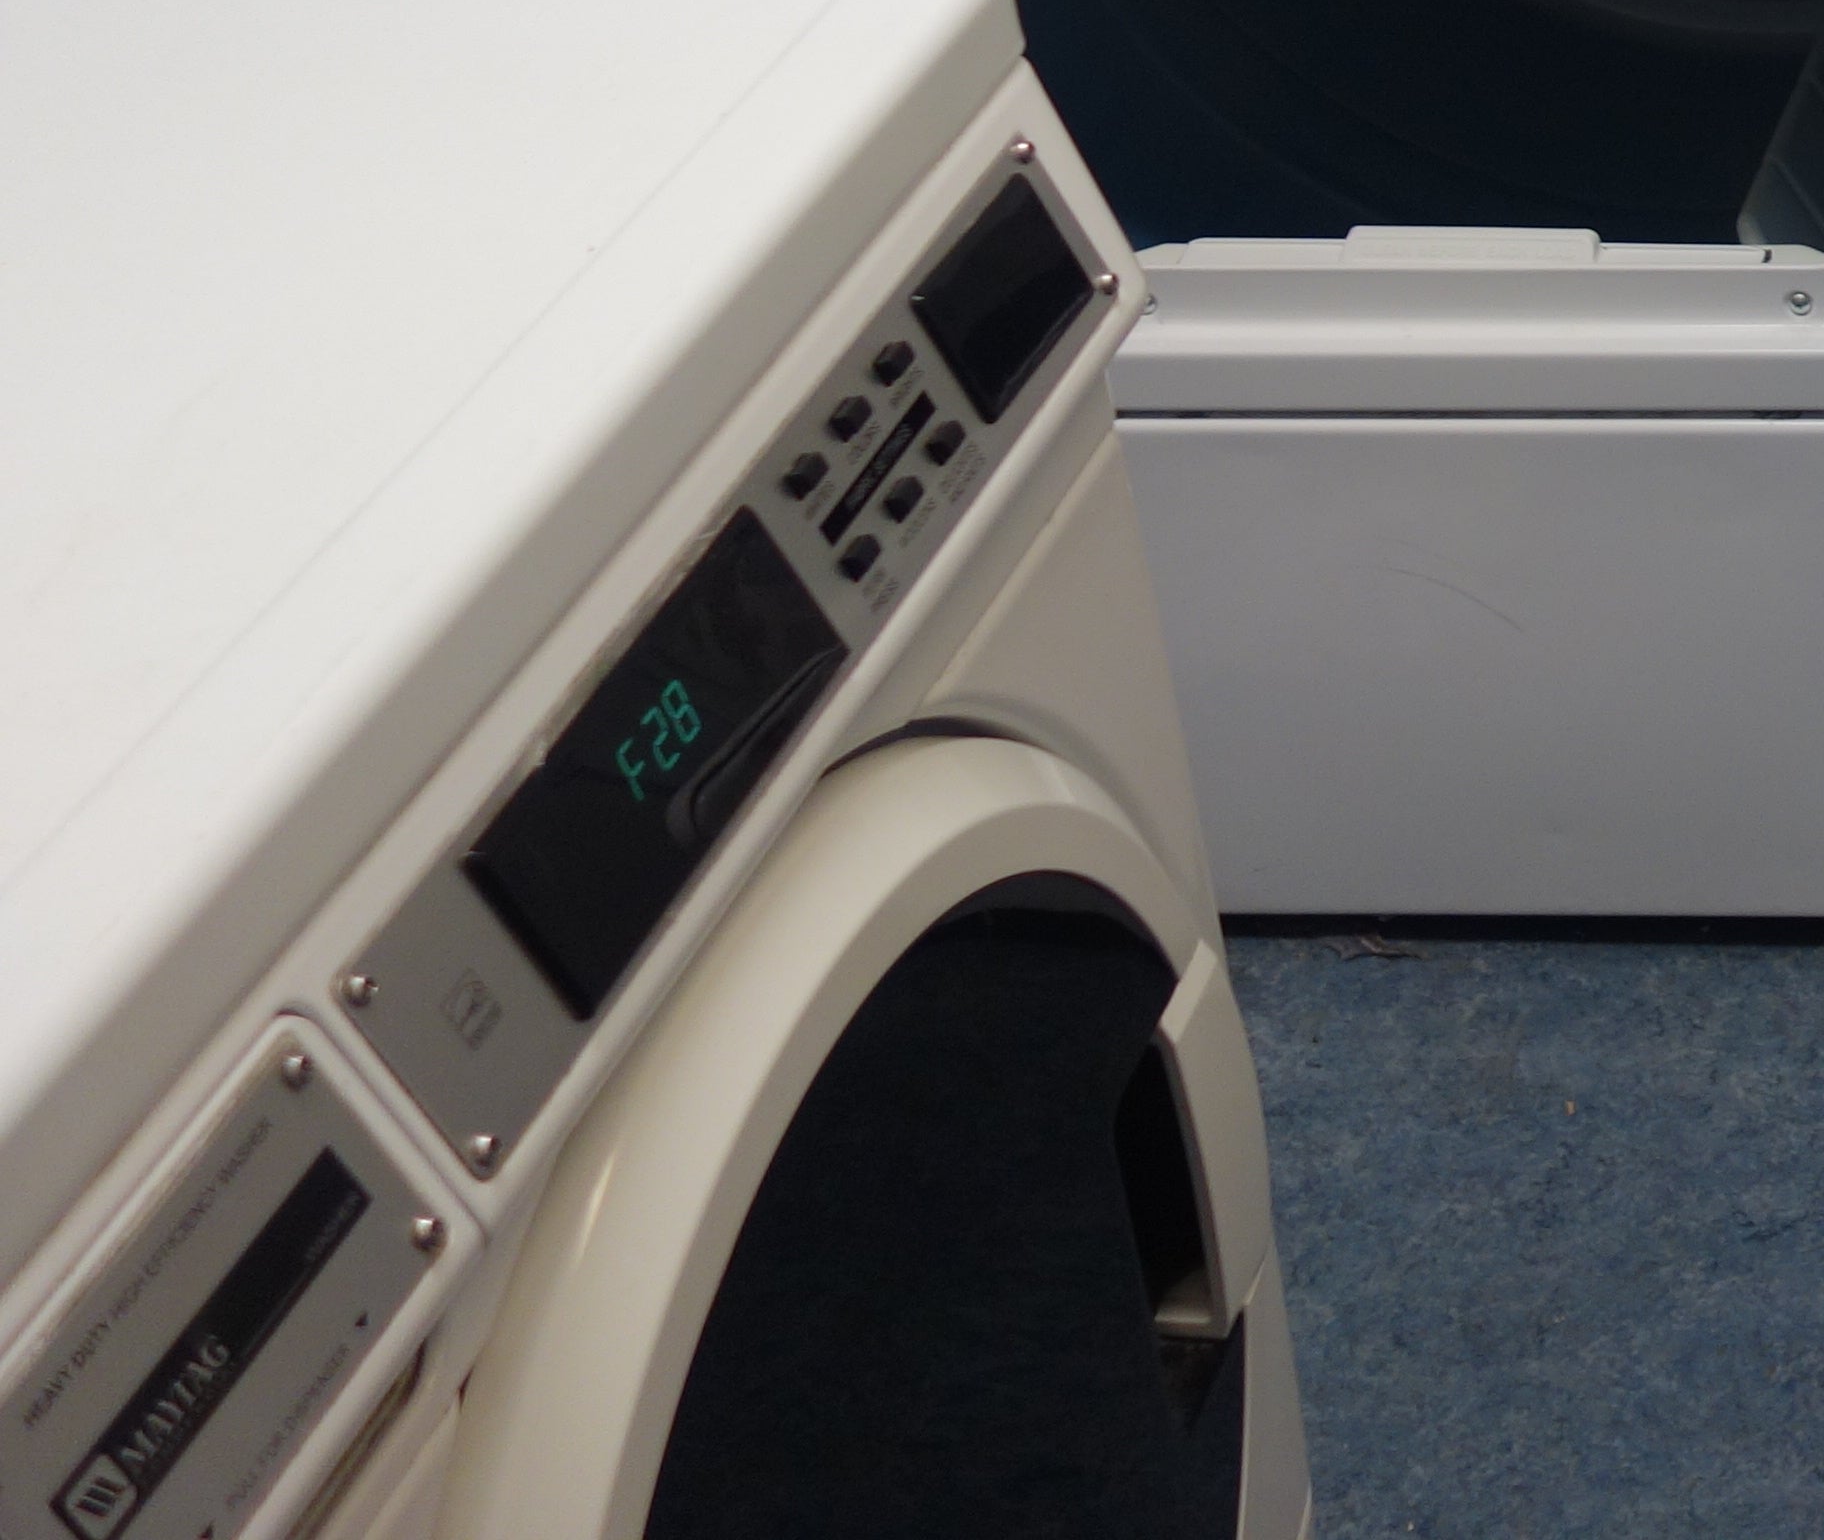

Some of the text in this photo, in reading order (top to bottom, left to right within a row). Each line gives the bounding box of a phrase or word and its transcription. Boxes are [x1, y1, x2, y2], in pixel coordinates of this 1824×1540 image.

[615, 678, 703, 801] F28
[20, 1114, 274, 1430] HEAVY DUTY HIGH EFFICIENCY WASHER
[115, 1333, 233, 1475] MAYTAG
